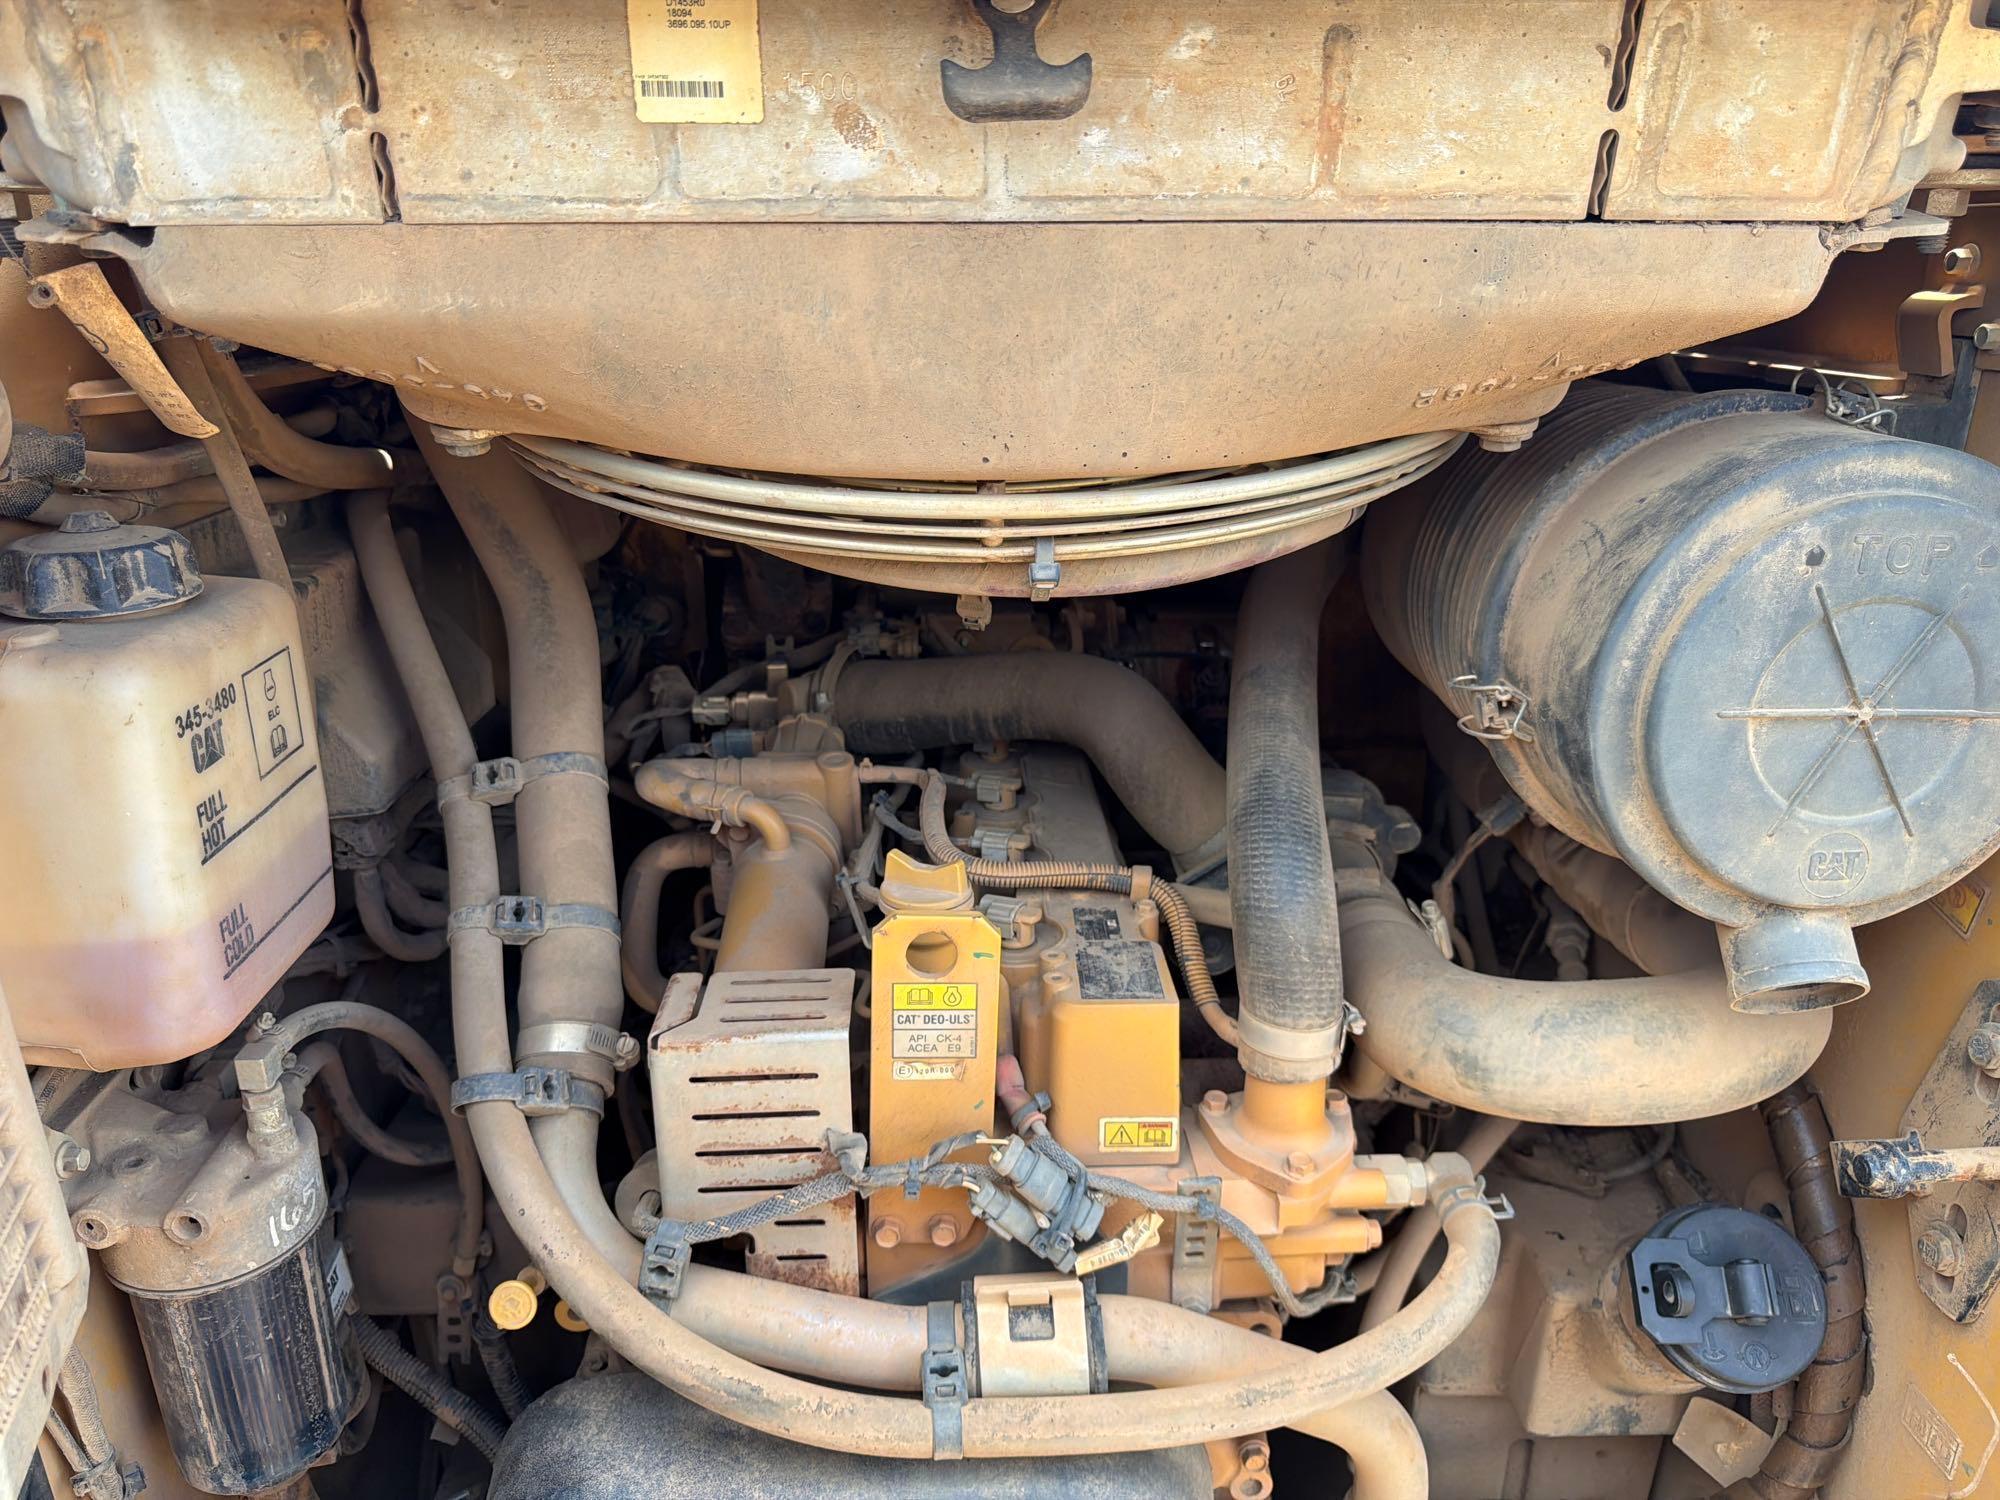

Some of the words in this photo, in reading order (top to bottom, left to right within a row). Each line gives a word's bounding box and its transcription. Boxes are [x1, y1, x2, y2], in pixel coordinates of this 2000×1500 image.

[667, 8, 692, 17] 18094
[1853, 534, 1954, 576] TOP
[175, 683, 236, 738] 345-3480
[267, 705, 281, 721] ELC
[191, 719, 225, 774] CAT
[196, 789, 227, 828] FULL
[201, 817, 227, 855] HOT
[1807, 849, 1864, 881] CAT
[219, 903, 249, 943] FULL
[224, 924, 254, 967] COLD
[907, 1043, 938, 1052] ACEA
[947, 1043, 962, 1052] E9
[908, 1034, 927, 1043] API
[936, 1034, 962, 1043] CK-4
